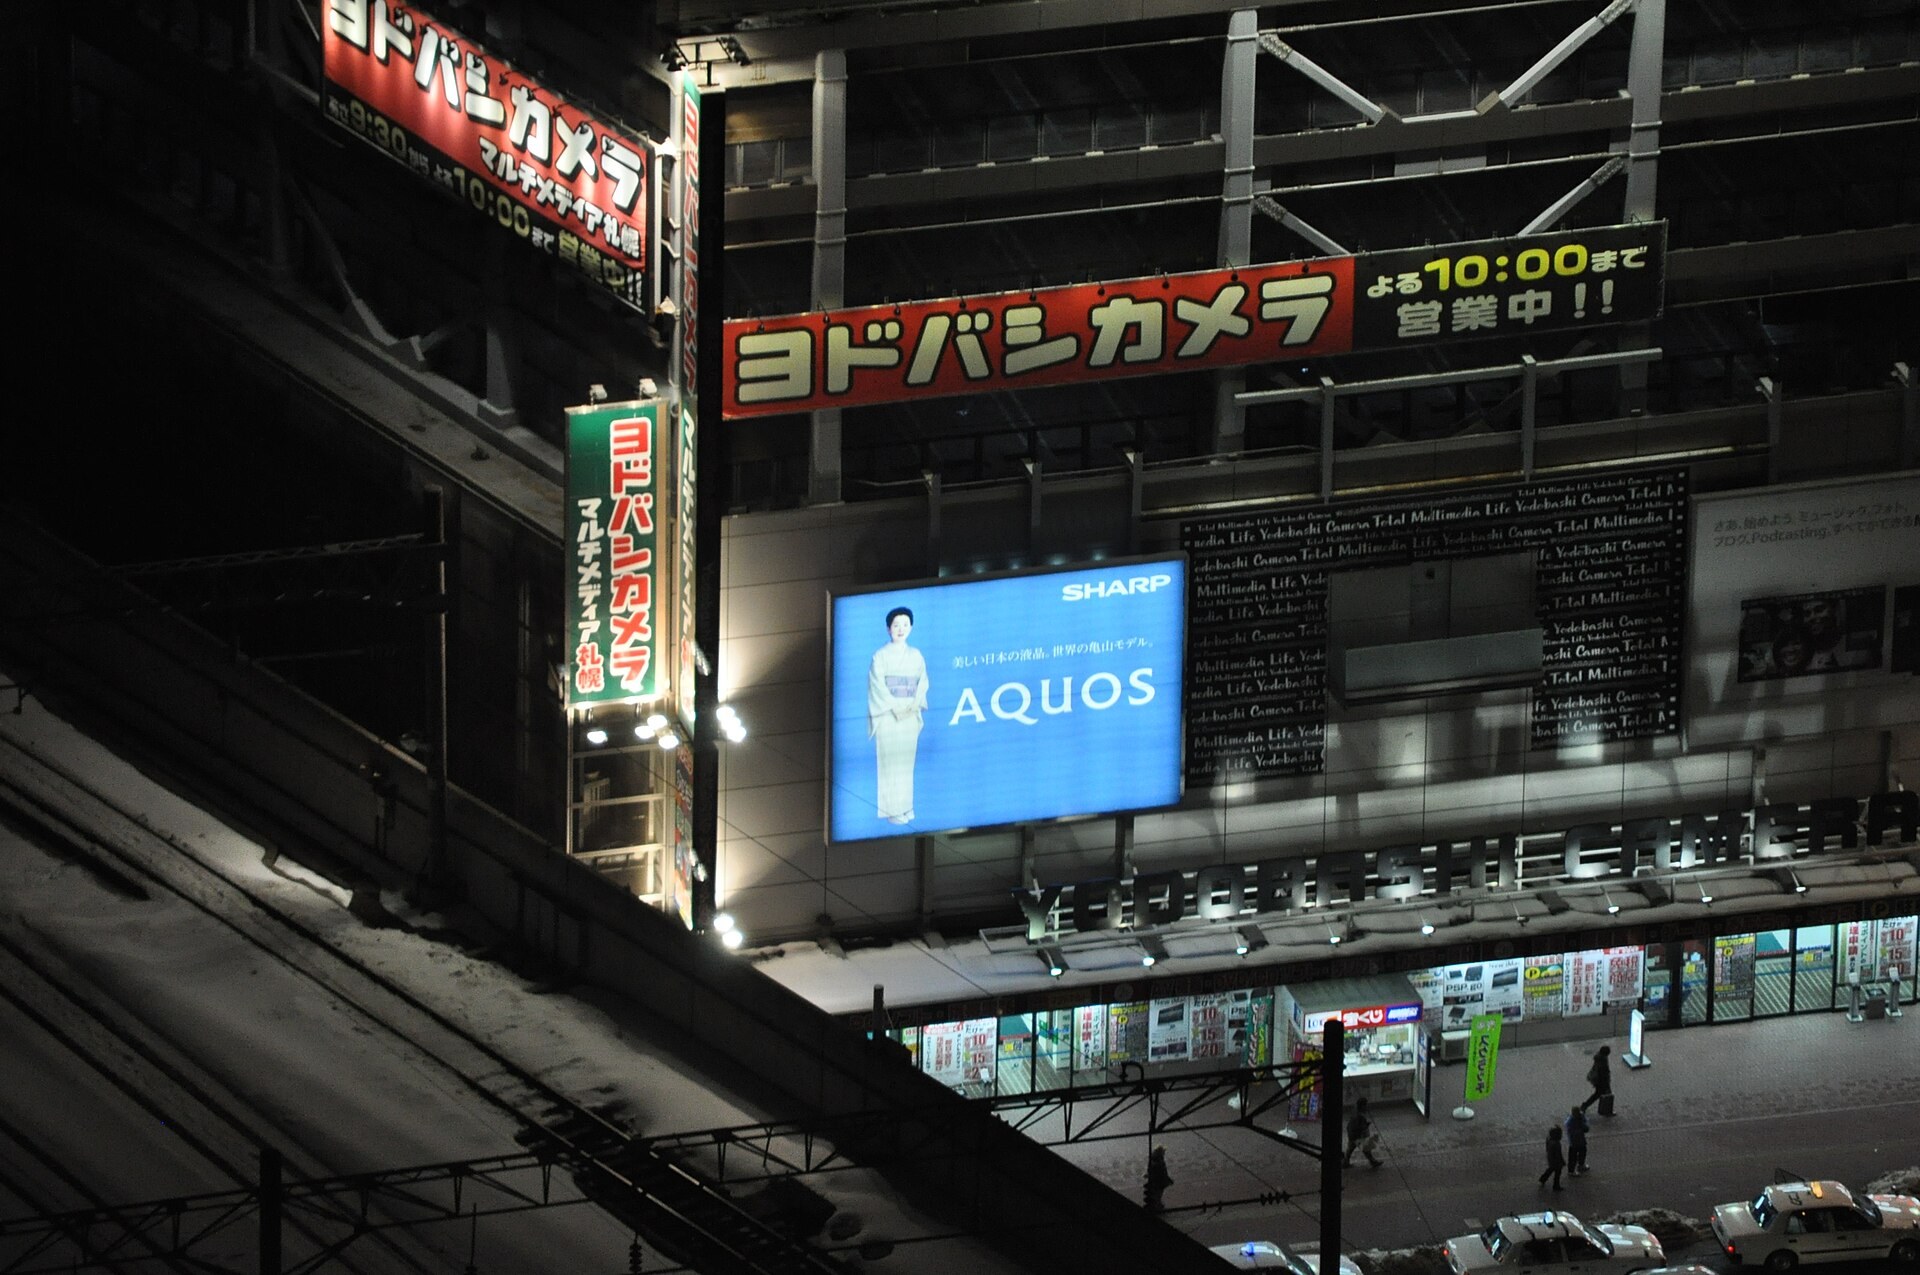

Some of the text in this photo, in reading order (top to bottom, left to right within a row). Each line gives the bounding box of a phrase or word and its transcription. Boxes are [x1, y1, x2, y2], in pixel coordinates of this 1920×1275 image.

[329, 0, 644, 212] ヨドバシカメラ
[479, 136, 641, 259] マルチメディア札幌
[1367, 244, 1648, 298] よる10:00まで
[738, 275, 1333, 403] ヨドバシカメラ
[576, 498, 605, 694] マルチメディア札幌
[608, 417, 653, 692] ヨドバシカメラ
[1062, 575, 1172, 601] SHARP
[948, 667, 1156, 725] AQUOS
[1010, 790, 1920, 940] YODOBASHI CAMERA
